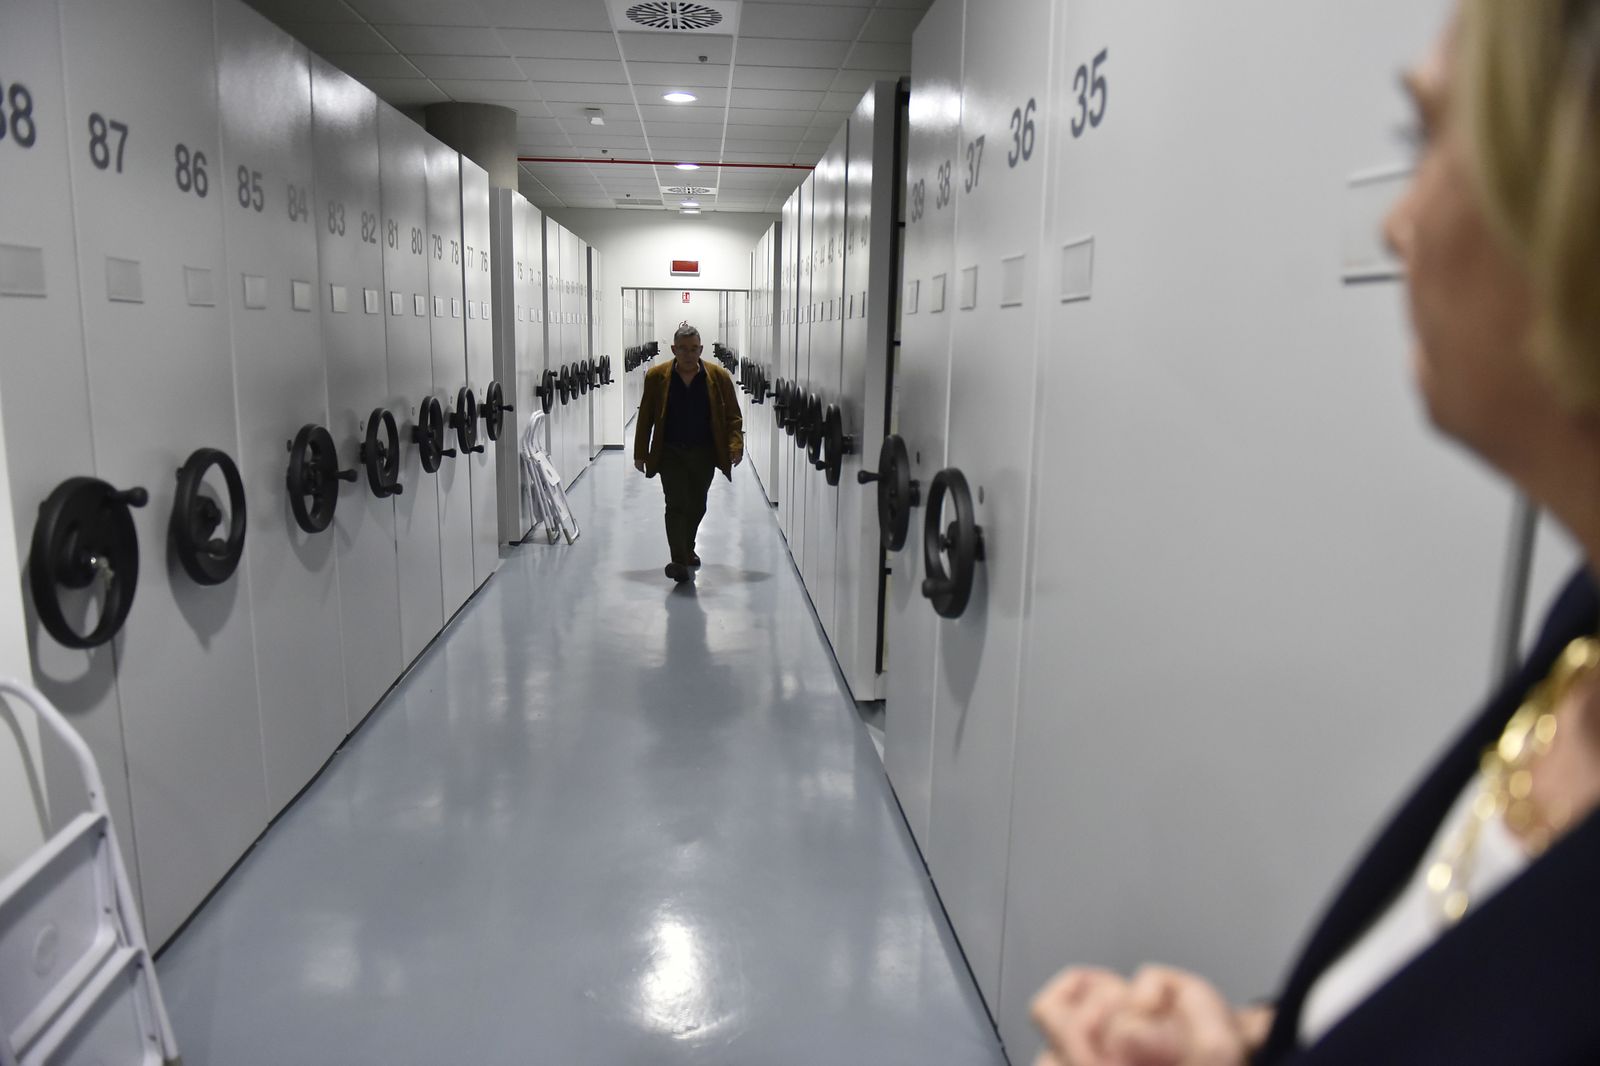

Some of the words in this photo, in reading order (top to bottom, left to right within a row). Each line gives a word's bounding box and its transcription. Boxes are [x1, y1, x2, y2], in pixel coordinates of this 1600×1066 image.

[1070, 47, 1107, 138] 35
[88, 112, 128, 174] 87
[1008, 97, 1036, 168] 36
[175, 143, 208, 198] 86
[965, 134, 985, 193] 37
[237, 165, 264, 212] 85
[287, 184, 308, 223] 84
[911, 178, 925, 223] 39
[936, 160, 951, 210] 38
[327, 201, 345, 236] 83
[361, 211, 376, 244] 82
[388, 219, 399, 250] 81
[411, 228, 423, 255] 80
[432, 234, 442, 260] 79
[450, 240, 459, 265] 78
[466, 246, 474, 268] 77
[480, 251, 488, 272] 76
